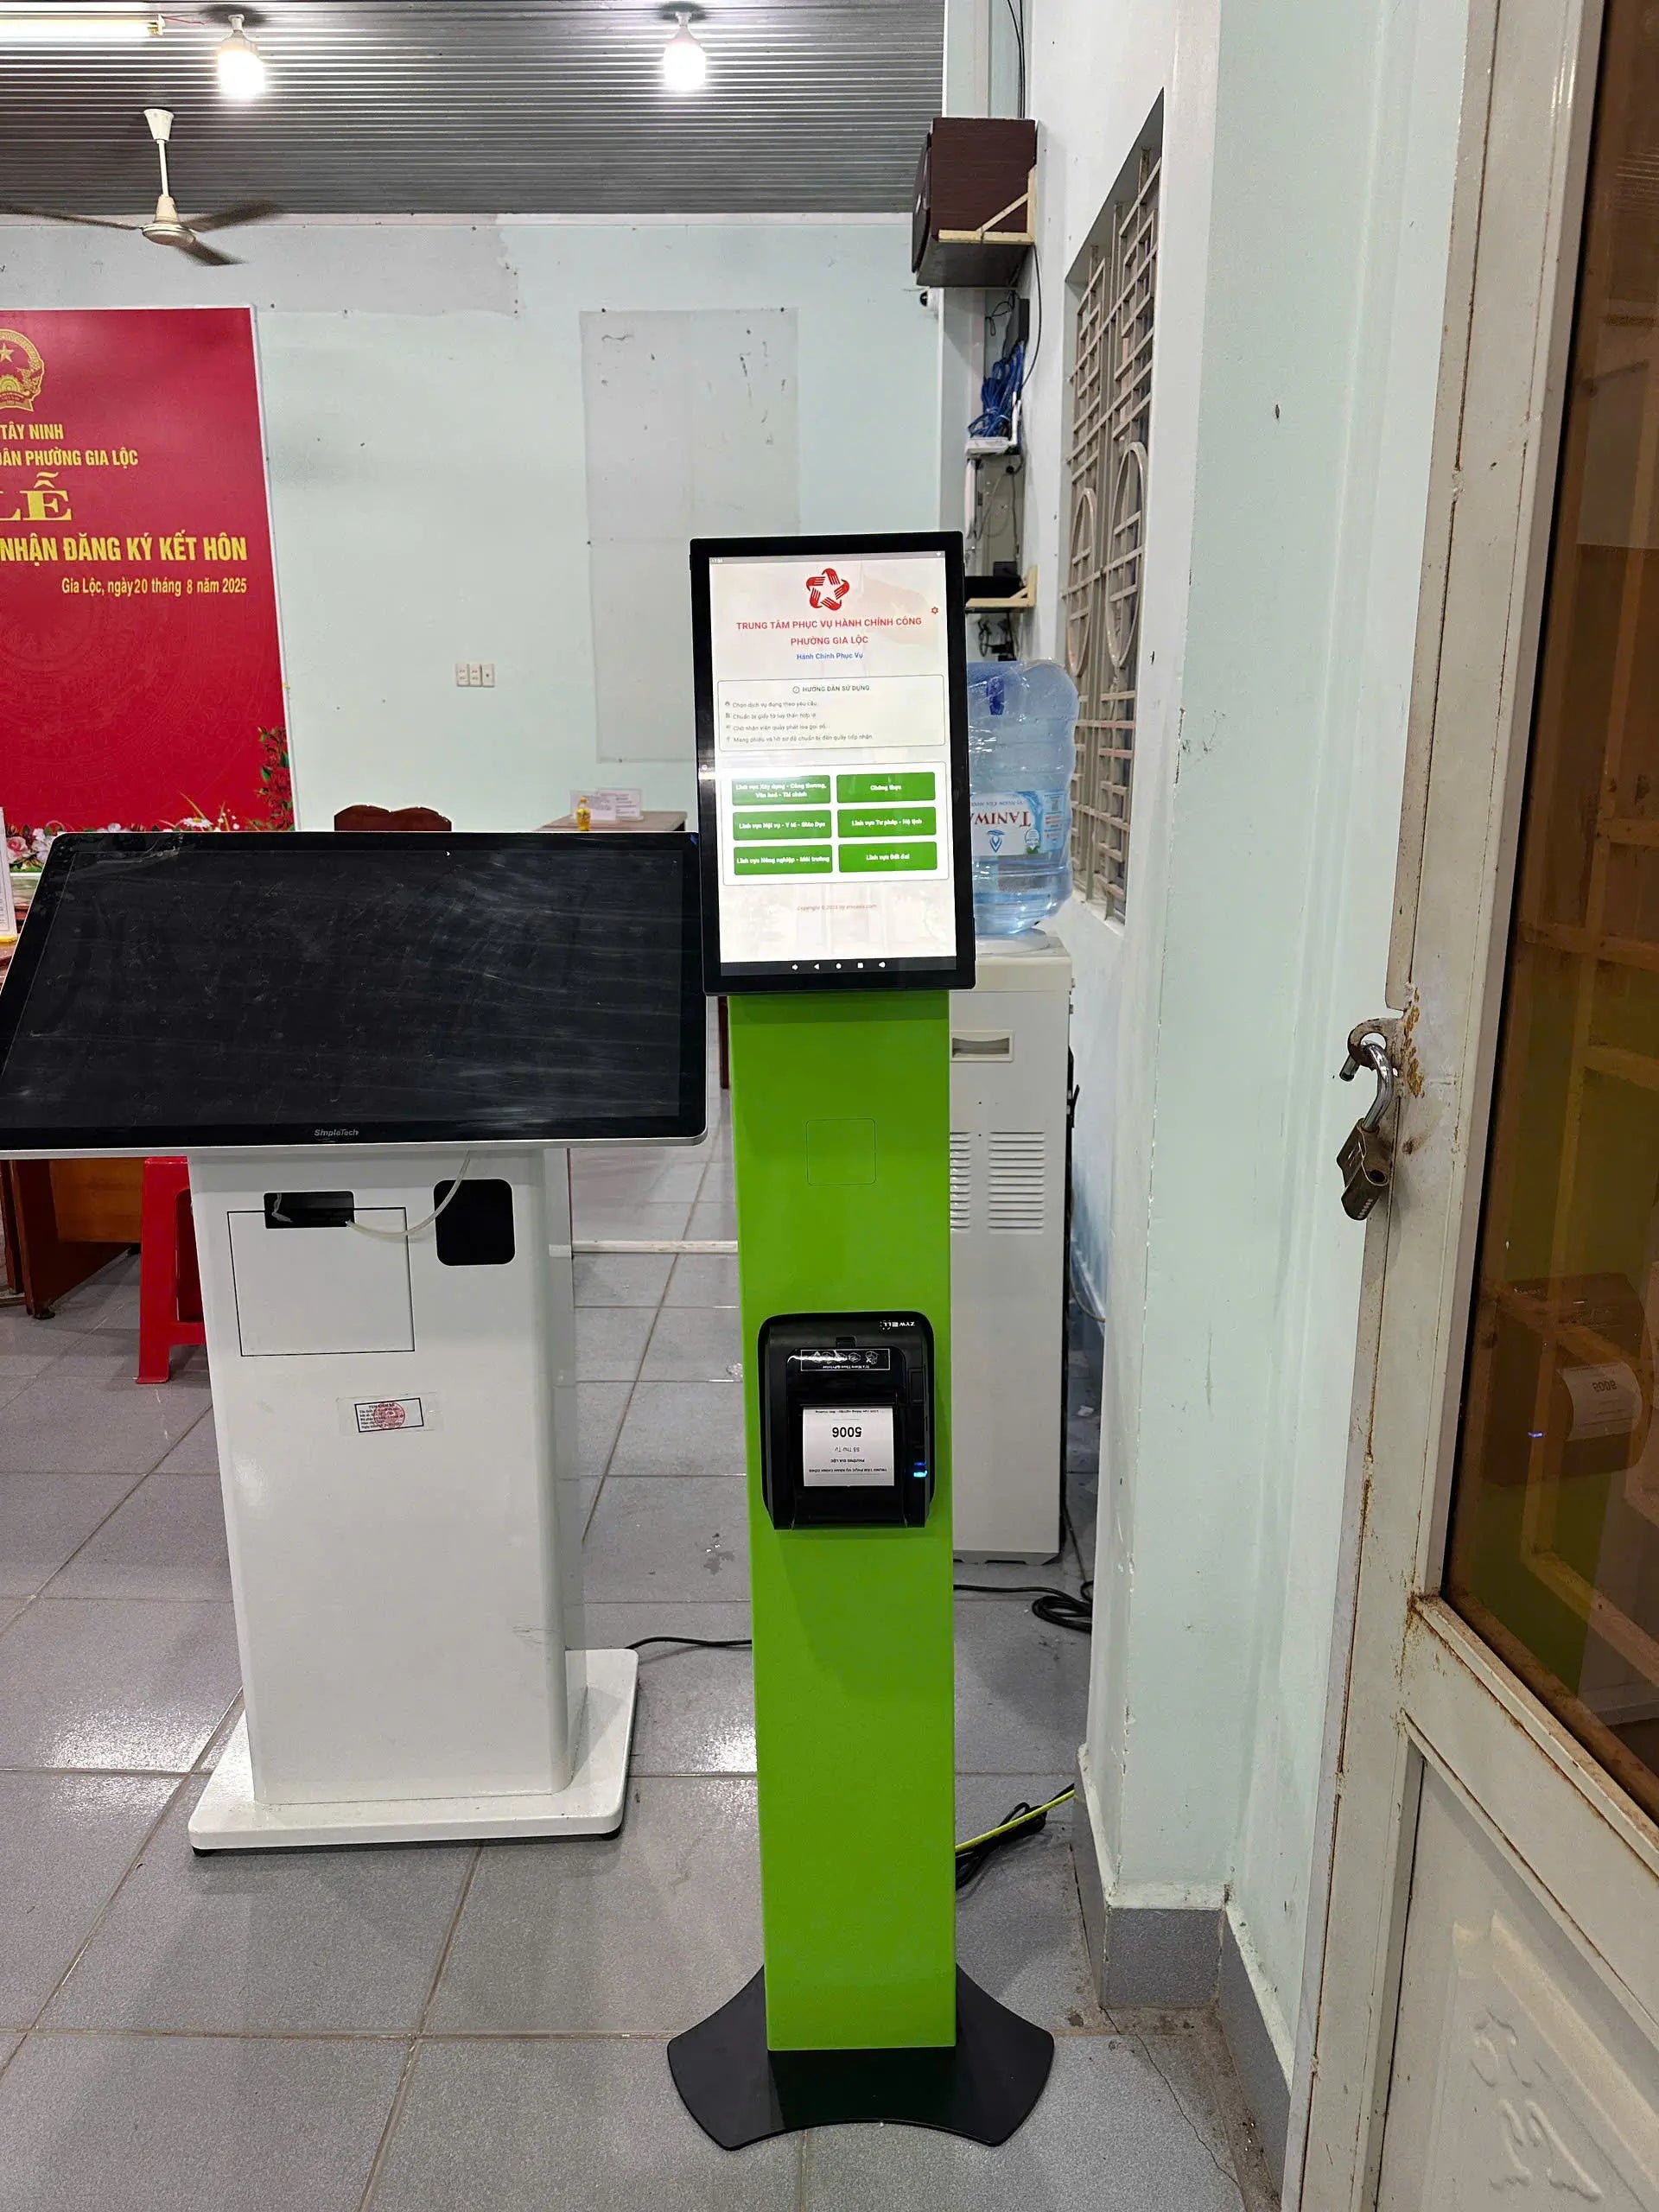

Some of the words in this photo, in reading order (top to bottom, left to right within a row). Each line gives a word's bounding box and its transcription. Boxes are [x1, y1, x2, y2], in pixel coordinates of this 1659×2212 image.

[0, 422, 25, 440] TÂY
[29, 424, 64, 440] NINH
[25, 447, 82, 466] PHƯỜNG
[86, 450, 109, 466] GIA
[112, 447, 138, 468] LỘC
[0, 533, 58, 566] NHẬN
[63, 533, 121, 561] ĐĂNG
[127, 532, 152, 561] KÝ
[160, 530, 197, 560] KẾT
[203, 532, 247, 560] HÔN
[62, 578, 79, 594] Gia
[82, 577, 105, 596] Lộc,
[107, 579, 134, 597] ngày
[134, 579, 148, 594] 20
[151, 577, 181, 597] tháng
[187, 579, 193, 594] 8
[197, 578, 219, 594] năm
[222, 578, 247, 594] 2025
[736, 621, 767, 630] TRUNG
[770, 620, 790, 629] TÂM
[792, 620, 818, 631] PHỤC
[820, 620, 833, 629] VỤ
[835, 618, 861, 628] HÀNH
[864, 616, 893, 626] CHÍNH
[895, 616, 922, 626] CÔNG
[791, 635, 830, 646] PHƯỜNG
[850, 634, 868, 645] LỘC
[970, 810, 1032, 828] TANIW
[832, 1427, 862, 1438] 5006
